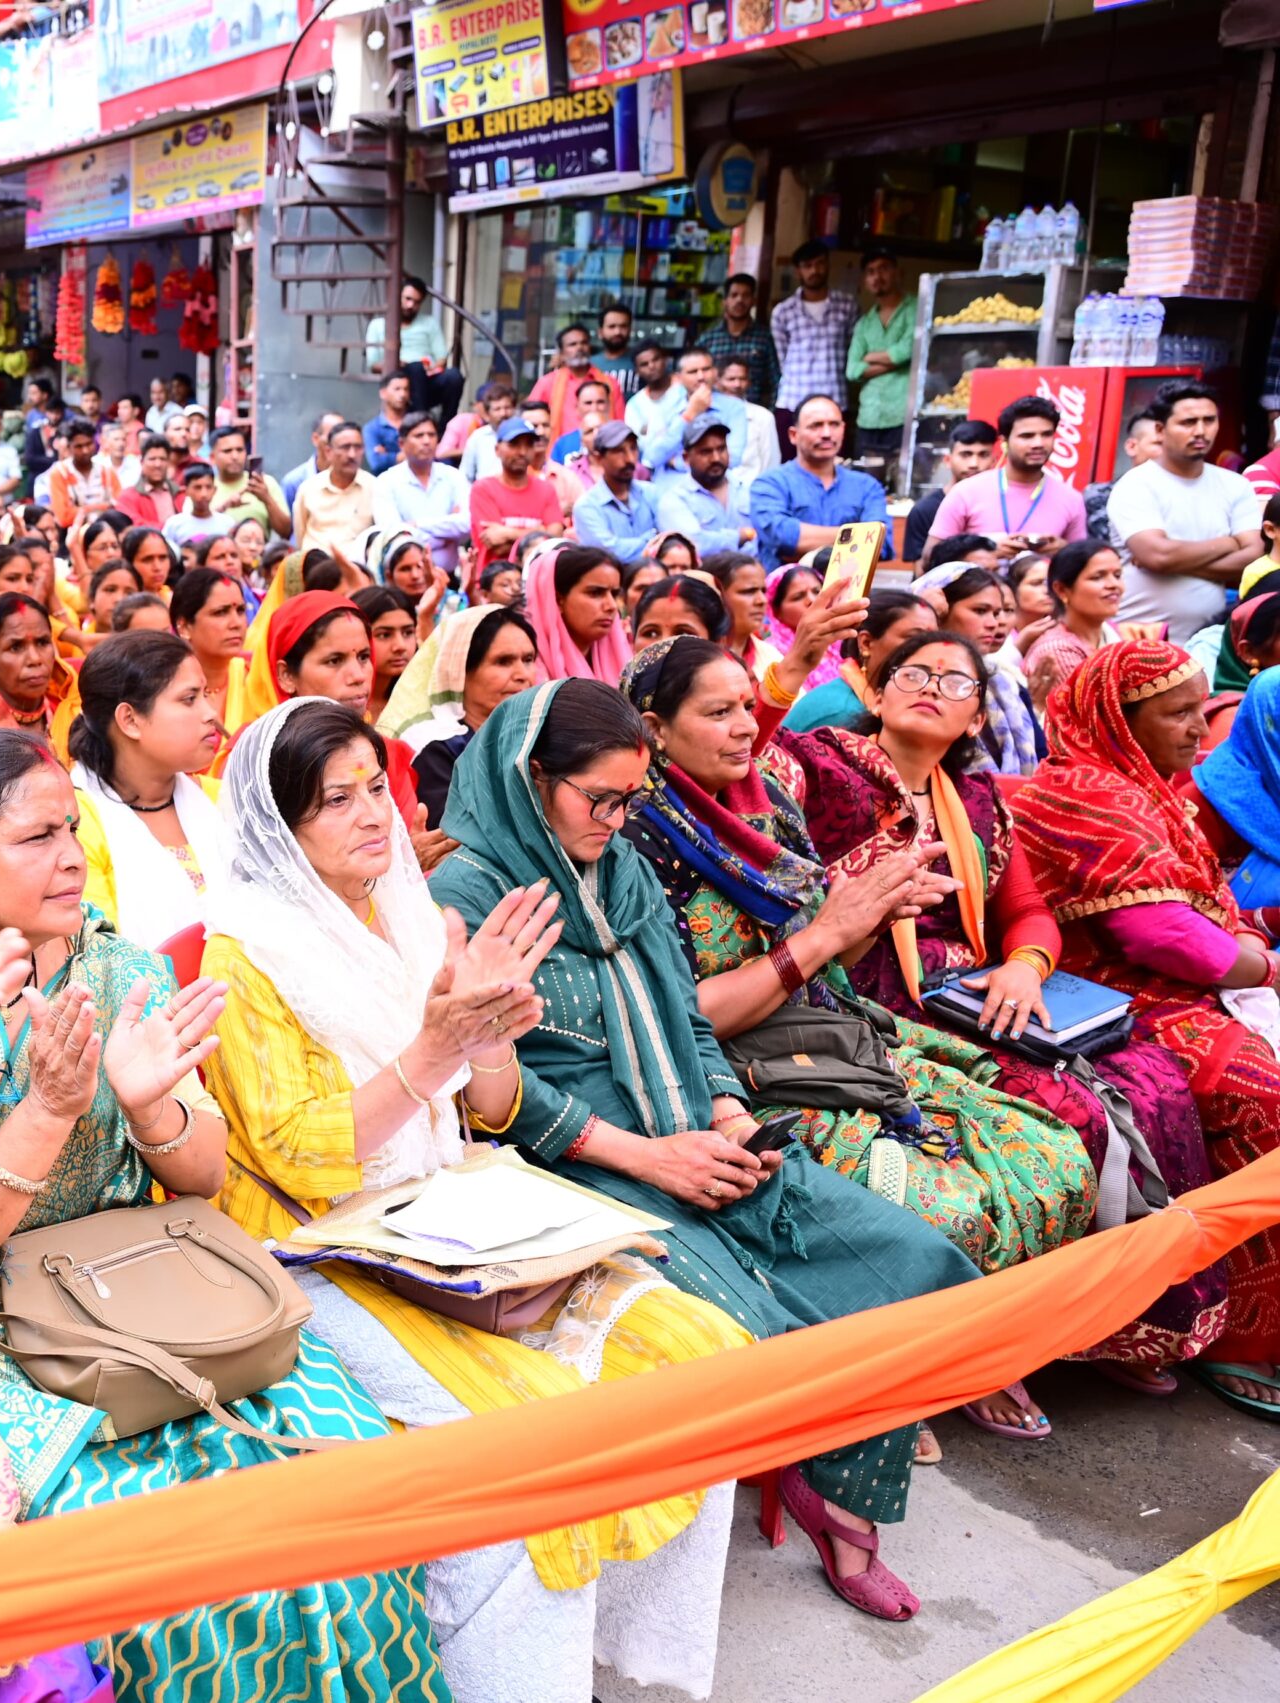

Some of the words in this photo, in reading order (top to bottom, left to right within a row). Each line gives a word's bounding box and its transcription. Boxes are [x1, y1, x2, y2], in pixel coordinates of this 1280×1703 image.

[418, 25, 445, 50] B.R.
[450, 0, 540, 42] ENTERPRISE
[446, 117, 481, 144] B.R.
[483, 90, 609, 137] ENTERPRISES
[1036, 376, 1086, 480] Cola
